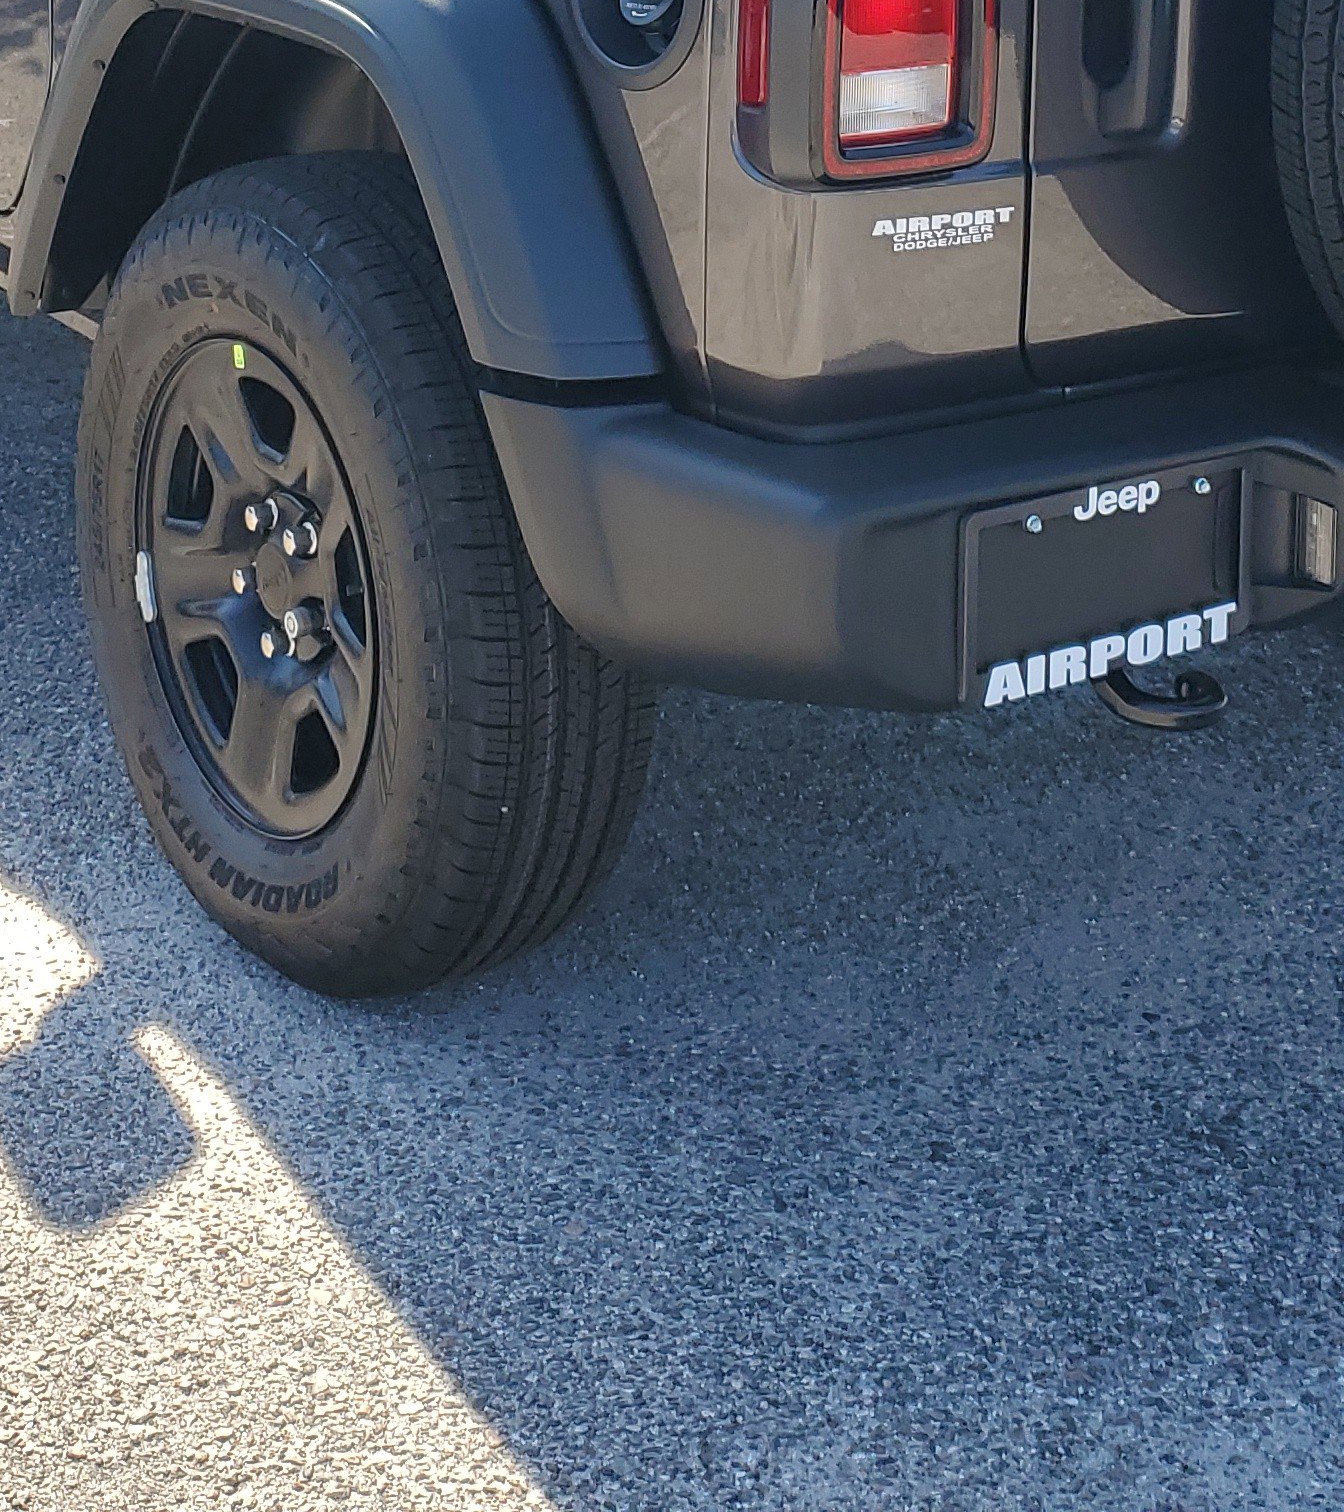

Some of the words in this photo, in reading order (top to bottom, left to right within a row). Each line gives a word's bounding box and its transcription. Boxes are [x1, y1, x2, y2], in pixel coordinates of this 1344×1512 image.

[871, 206, 1015, 236] AIRPORT
[892, 224, 994, 243] CHRYSLER
[892, 232, 994, 252] DODGE/JEEP
[160, 272, 298, 358] NEXEN
[1073, 479, 1161, 522] Jeep
[983, 601, 1238, 708] AIRPORT
[207, 856, 340, 914] ROADIAN
